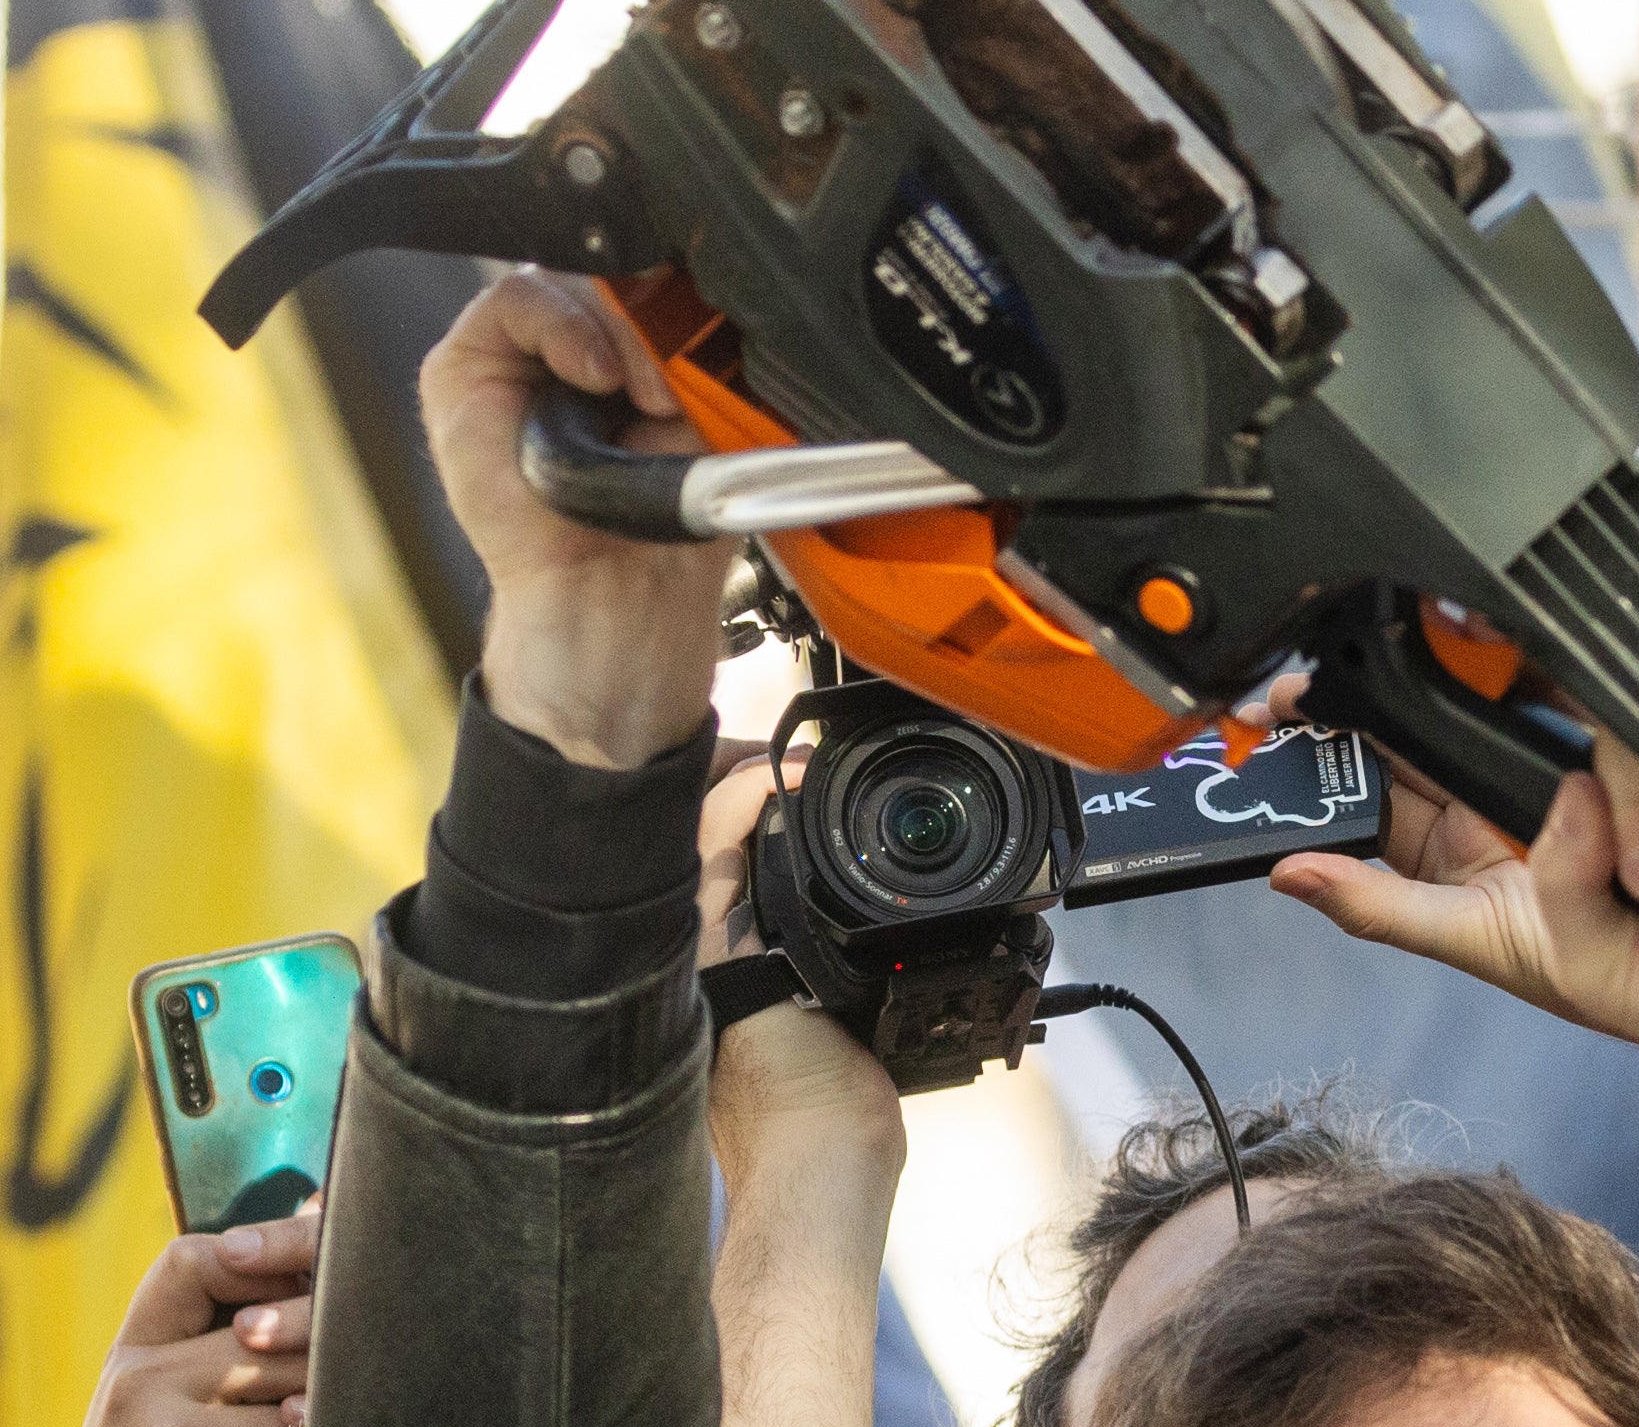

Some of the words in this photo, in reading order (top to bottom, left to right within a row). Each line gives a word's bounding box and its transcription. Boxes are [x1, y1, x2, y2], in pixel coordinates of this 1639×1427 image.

[896, 724, 920, 736] ZEISS
[1315, 744, 1324, 756] DEL
[1340, 741, 1350, 762] MILEI
[1317, 757, 1328, 784] CAMINO
[1324, 742, 1340, 792] LIBERTARIO
[1343, 762, 1355, 788] JAVIER
[1082, 786, 1157, 814] 4K
[1321, 785, 1329, 793] EL
[1127, 855, 1168, 869] AVCHD
[848, 863, 893, 901] Vario-Sonnar
